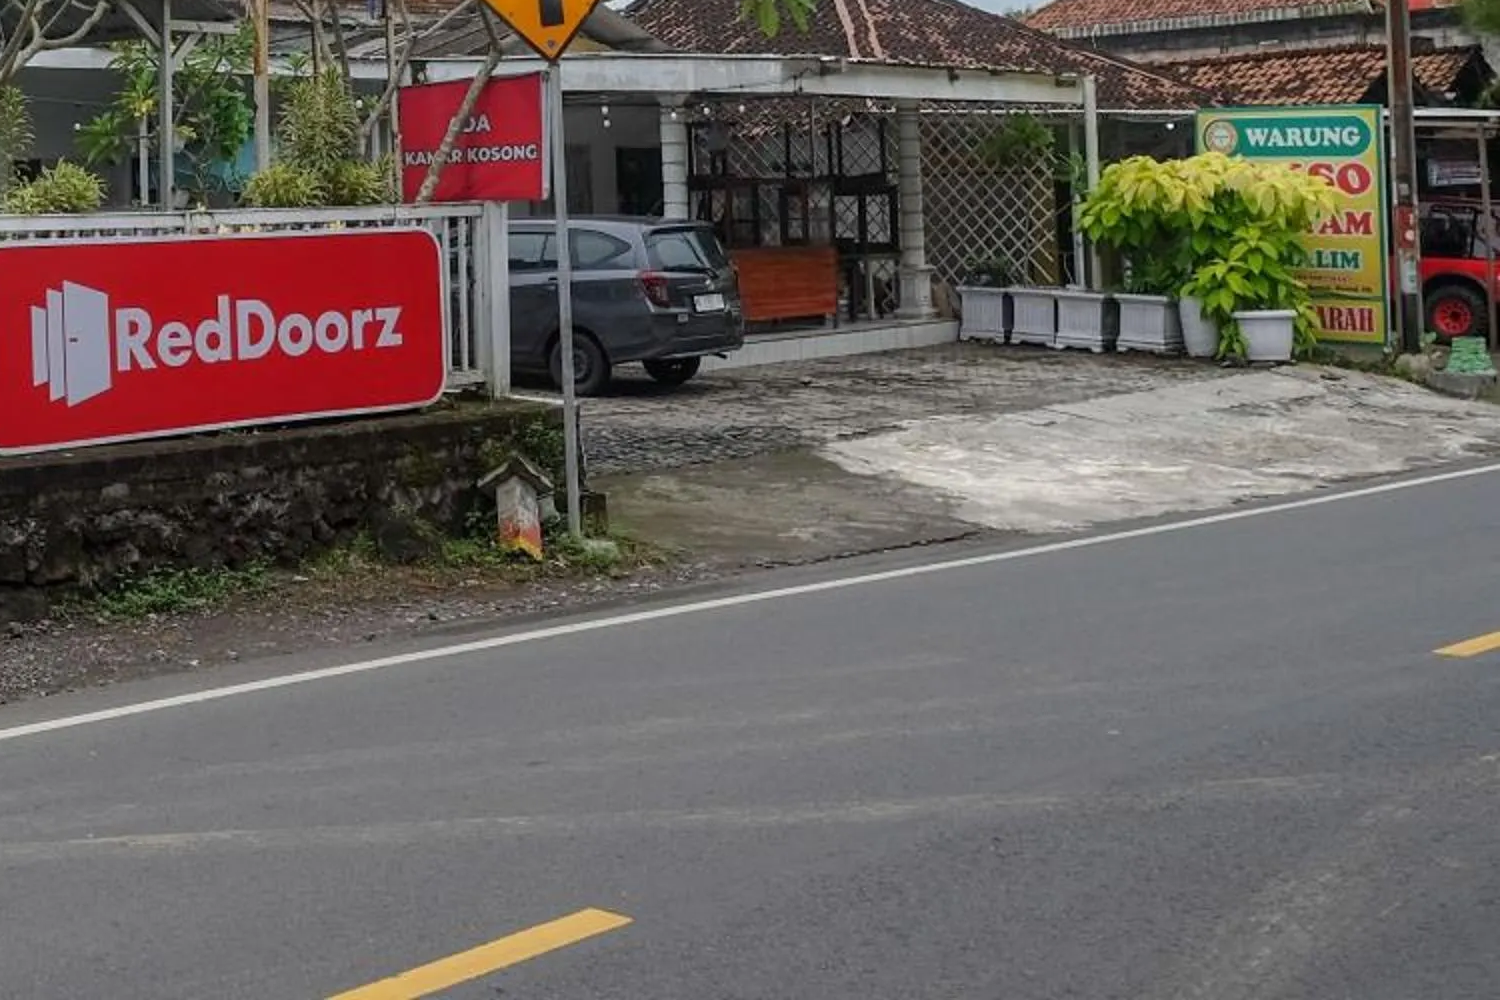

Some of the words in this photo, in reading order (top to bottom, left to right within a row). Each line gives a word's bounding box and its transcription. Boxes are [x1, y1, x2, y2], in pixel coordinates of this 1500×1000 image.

[1244, 126, 1361, 148] WARUNG
[467, 144, 537, 163] KOSONG
[114, 294, 403, 372] RedDoorz
